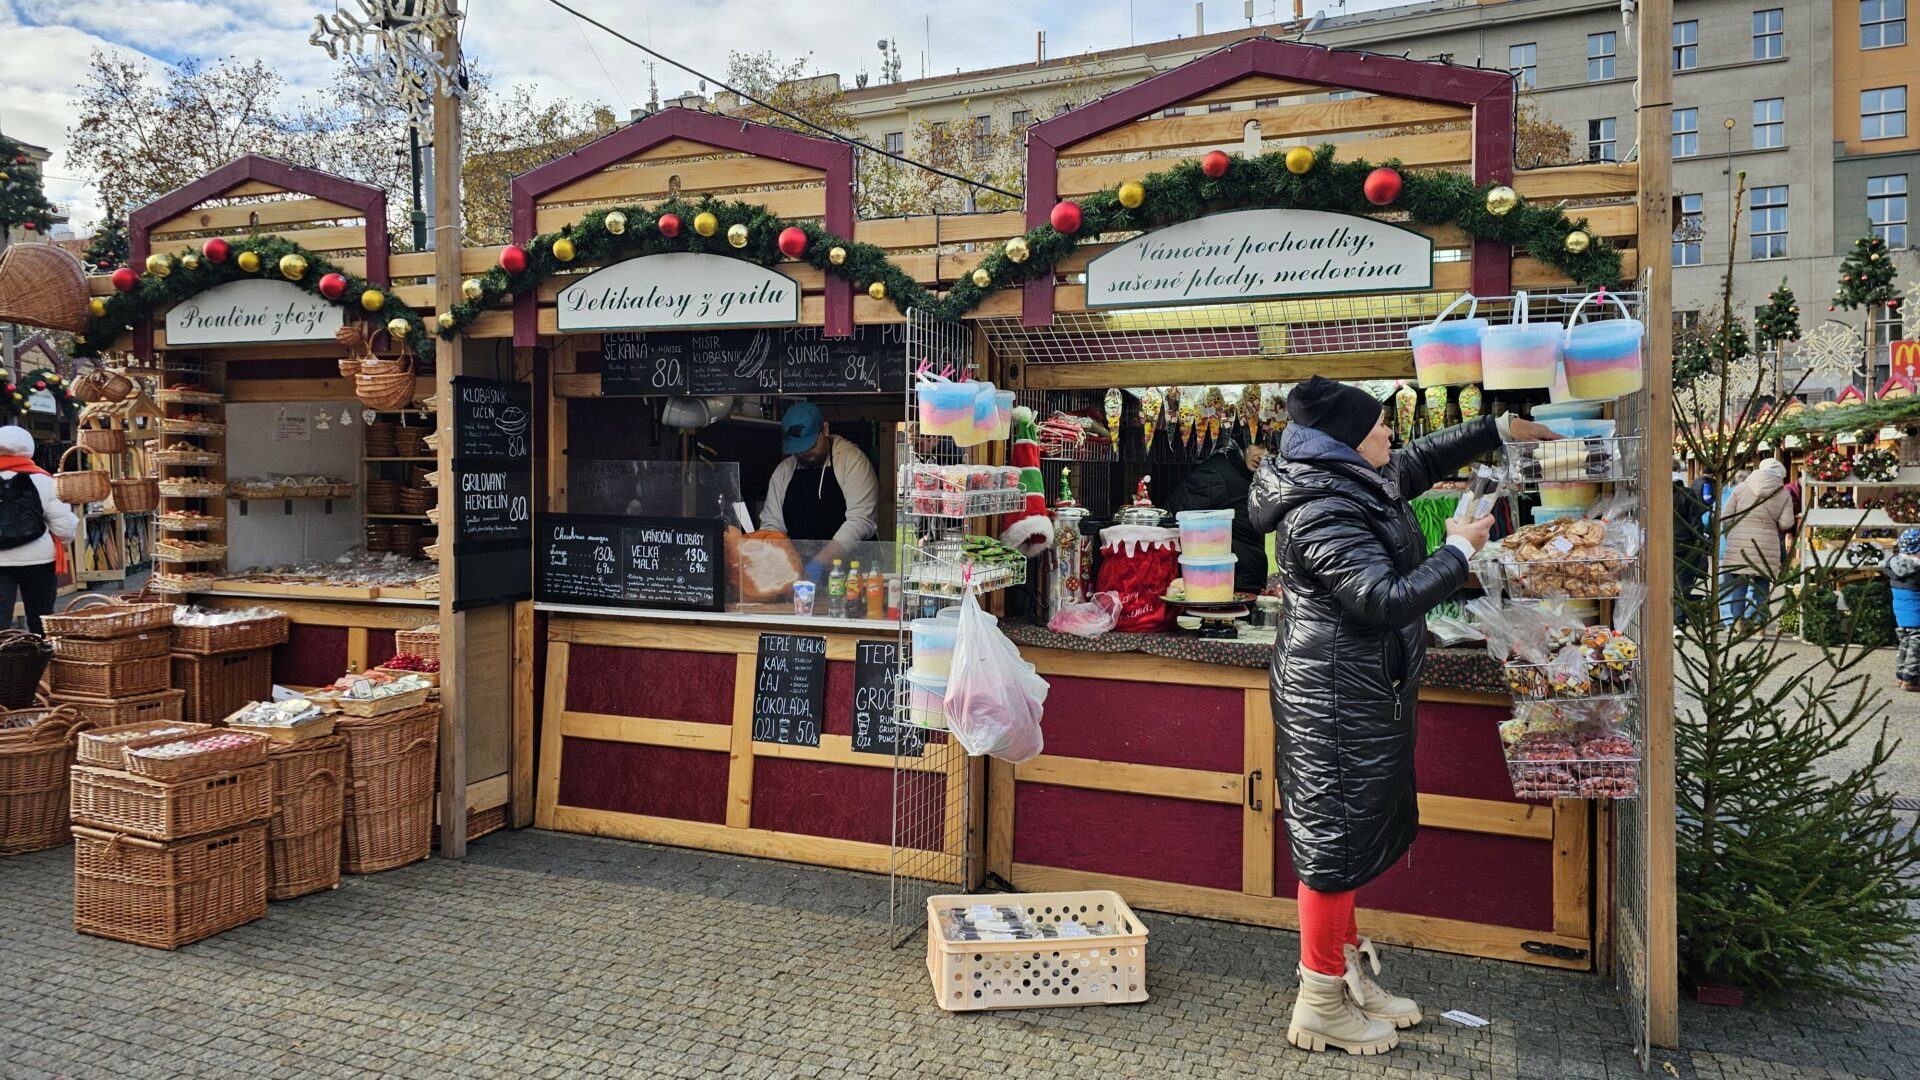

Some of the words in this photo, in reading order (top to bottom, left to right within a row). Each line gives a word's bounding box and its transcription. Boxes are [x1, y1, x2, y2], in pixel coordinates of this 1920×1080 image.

[1136, 238, 1235, 261] Vánoční
[1234, 227, 1375, 263] pochoutky,
[1108, 274, 1183, 293] sušené
[1184, 264, 1264, 296] plody,
[1273, 260, 1408, 283] medovina
[567, 285, 697, 318] Delikatesy
[697, 293, 714, 317] z
[716, 280, 790, 317] grilu
[180, 305, 270, 329] Proutěné
[271, 302, 329, 336] zboží
[692, 335, 720, 349] MISTR
[787, 344, 829, 366] ŠUNKA
[462, 471, 507, 491] GRILOVANÝ
[465, 491, 508, 510] HERMELÍN
[676, 532, 705, 546] KLOBÁSY
[631, 545, 661, 559] VELKÁ
[633, 558, 660, 570] MALÁ
[762, 635, 791, 652] TEPLÉ
[760, 671, 780, 692] ČAJ
